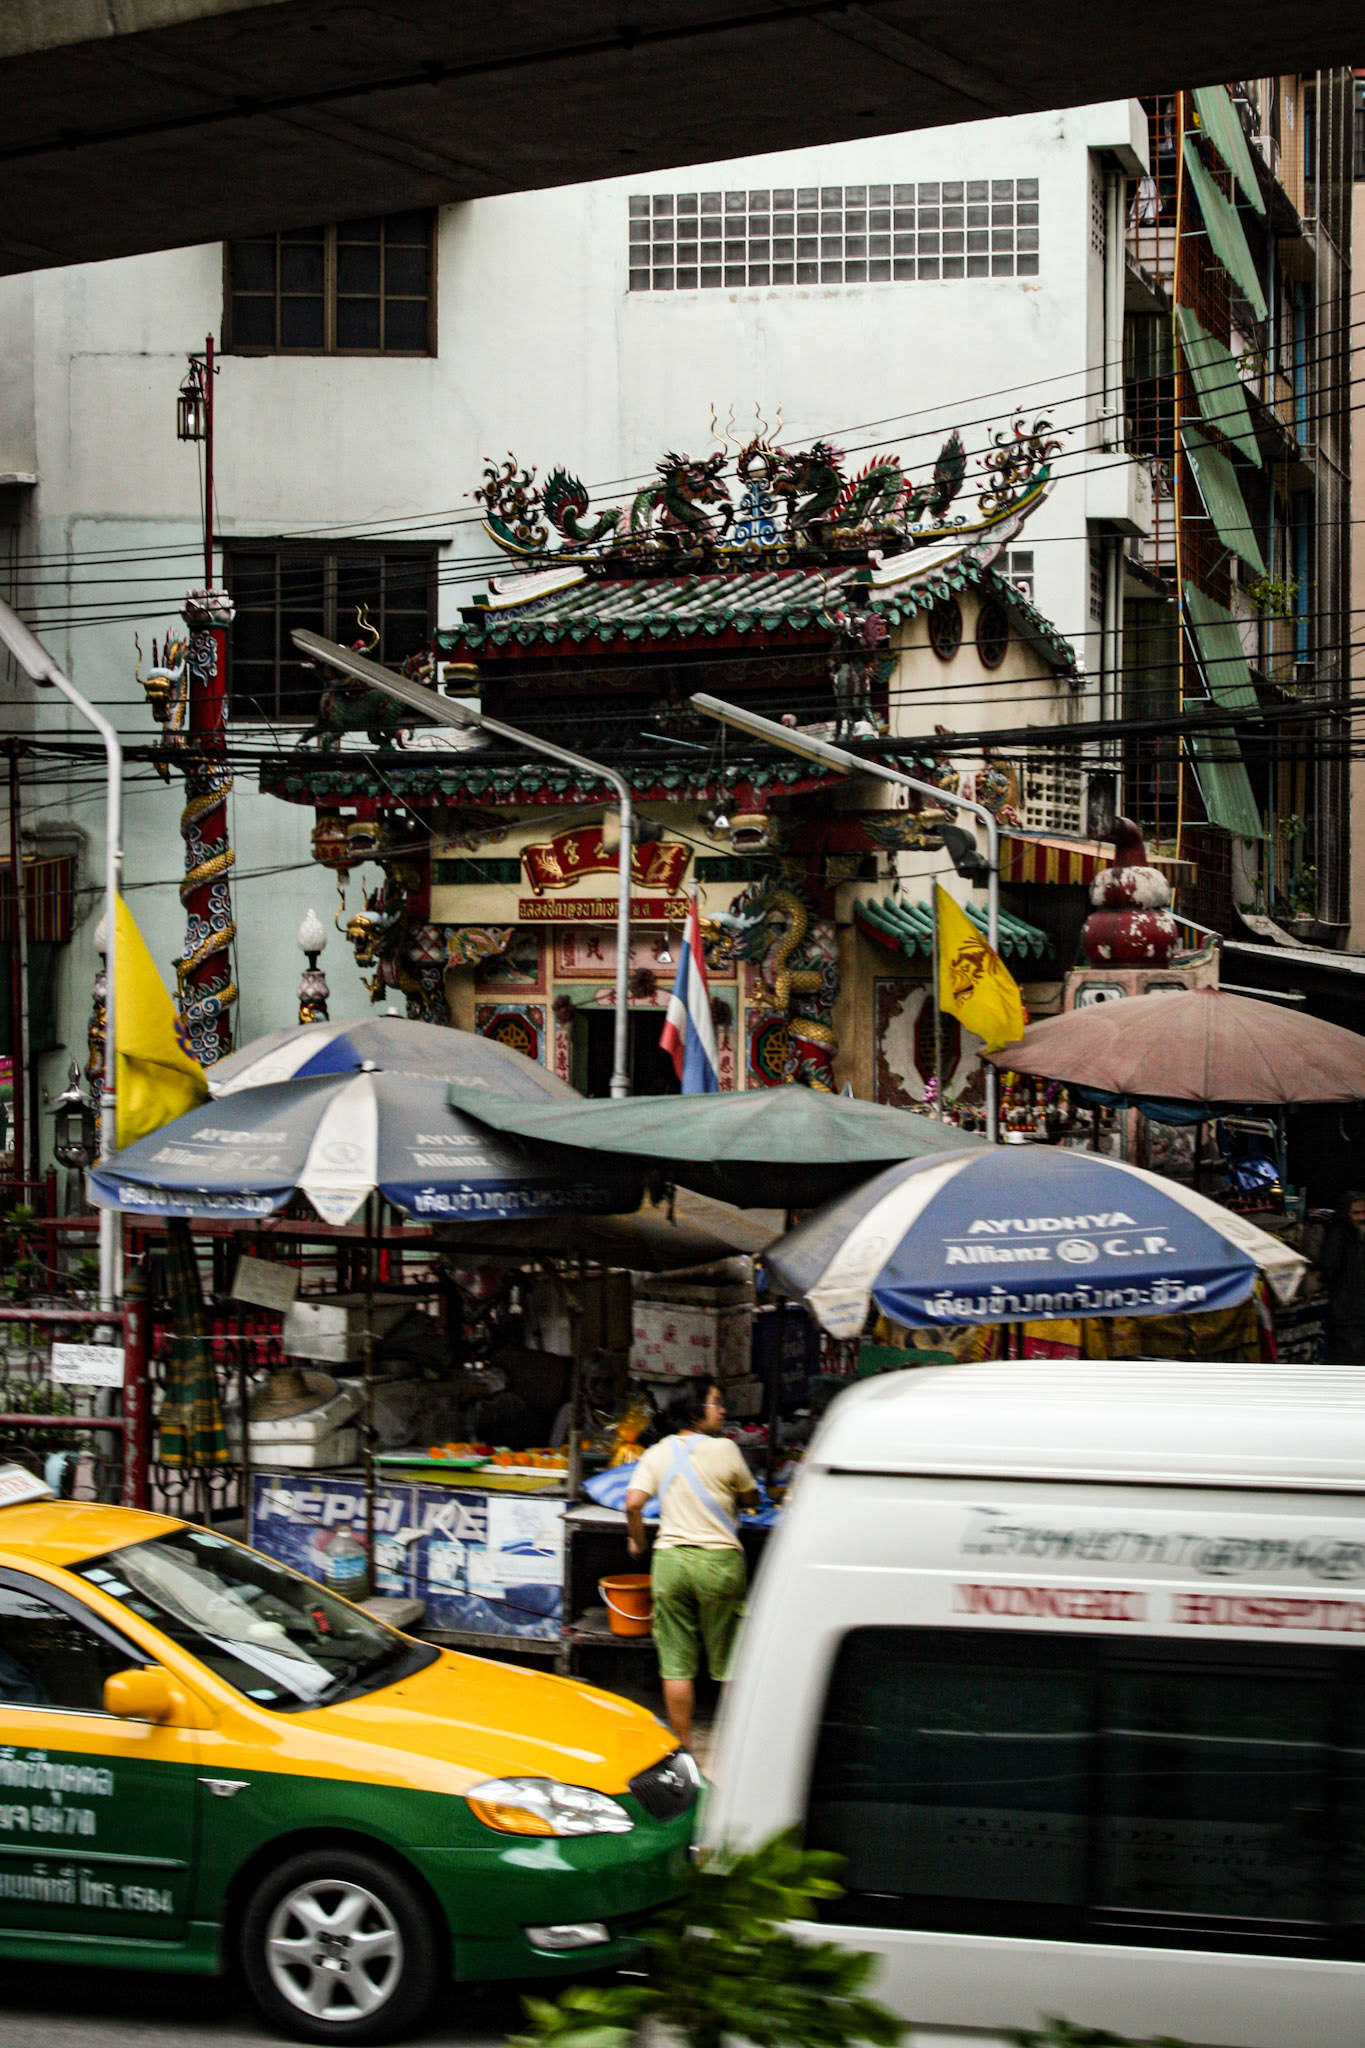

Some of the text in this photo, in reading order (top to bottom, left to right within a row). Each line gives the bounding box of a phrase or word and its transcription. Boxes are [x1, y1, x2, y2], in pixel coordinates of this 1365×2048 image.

[413, 1152, 492, 1168] Allianz
[967, 1211, 1137, 1235] AYUDHYA
[945, 1236, 1178, 1266] Allianz C.P.
[256, 1485, 404, 1533] PEPSI
